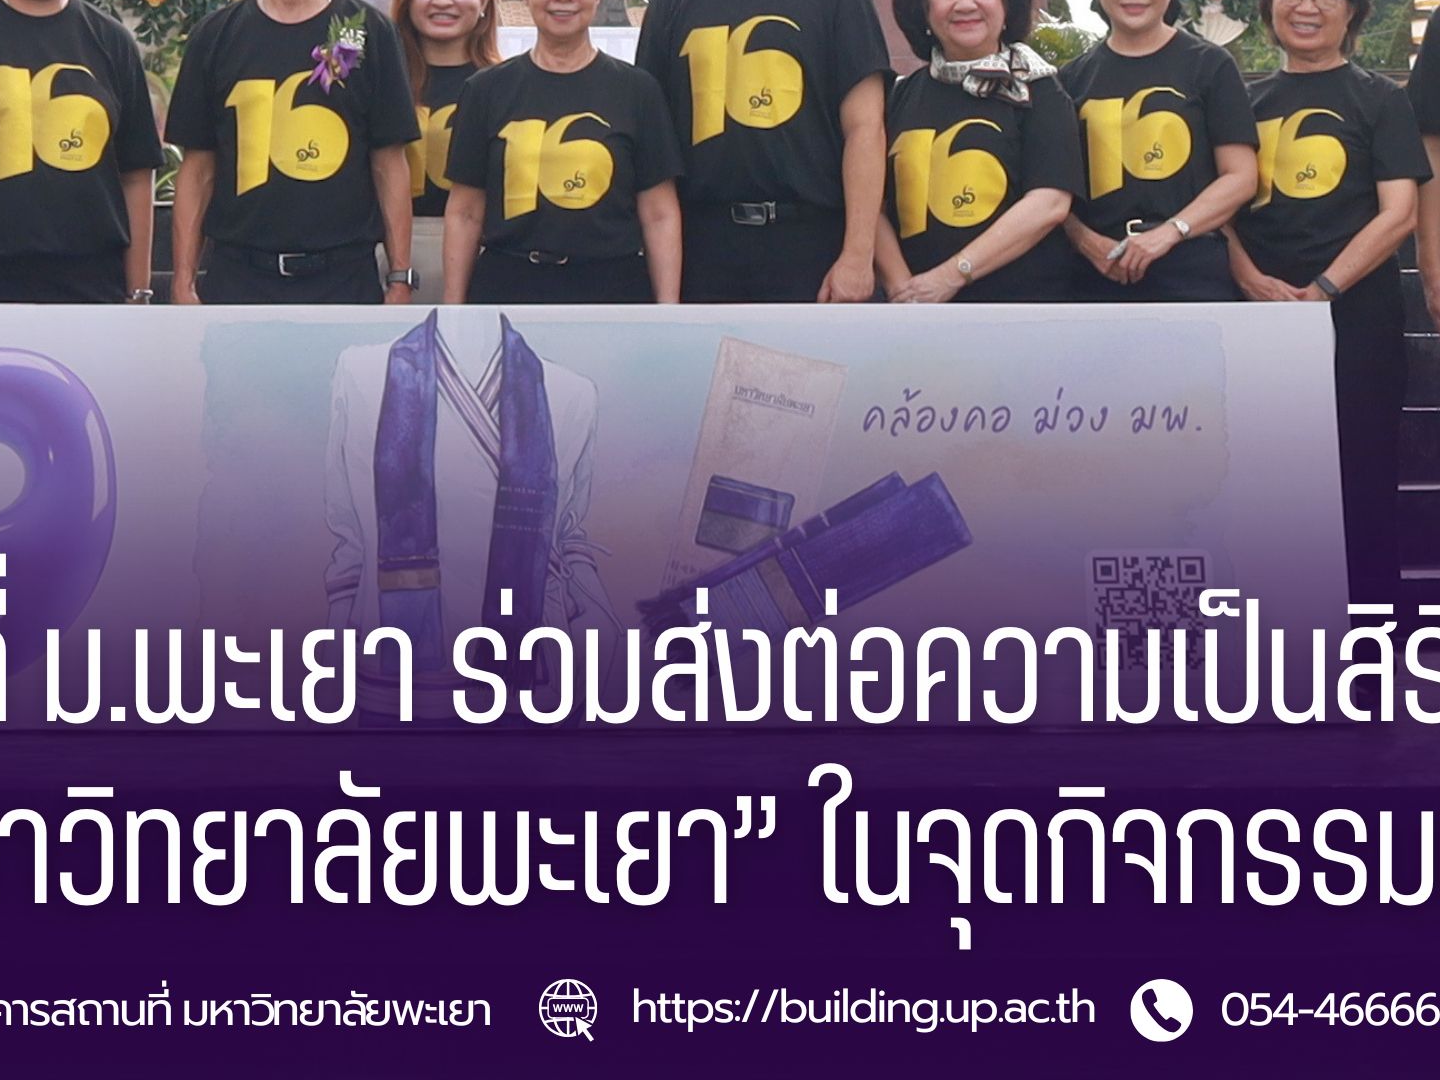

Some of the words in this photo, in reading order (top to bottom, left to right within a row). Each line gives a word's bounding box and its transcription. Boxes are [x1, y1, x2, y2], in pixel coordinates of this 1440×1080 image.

[224, 70, 350, 197] 16
[679, 15, 804, 146] 16
[498, 112, 615, 220] 16
[889, 118, 1008, 239] 16
[1079, 86, 1192, 201] 16
[1250, 108, 1348, 213] 16
[862, 388, 1012, 437] คล้องคอ
[1034, 387, 1109, 435] ม่วง
[1130, 405, 1203, 435] มพ.
